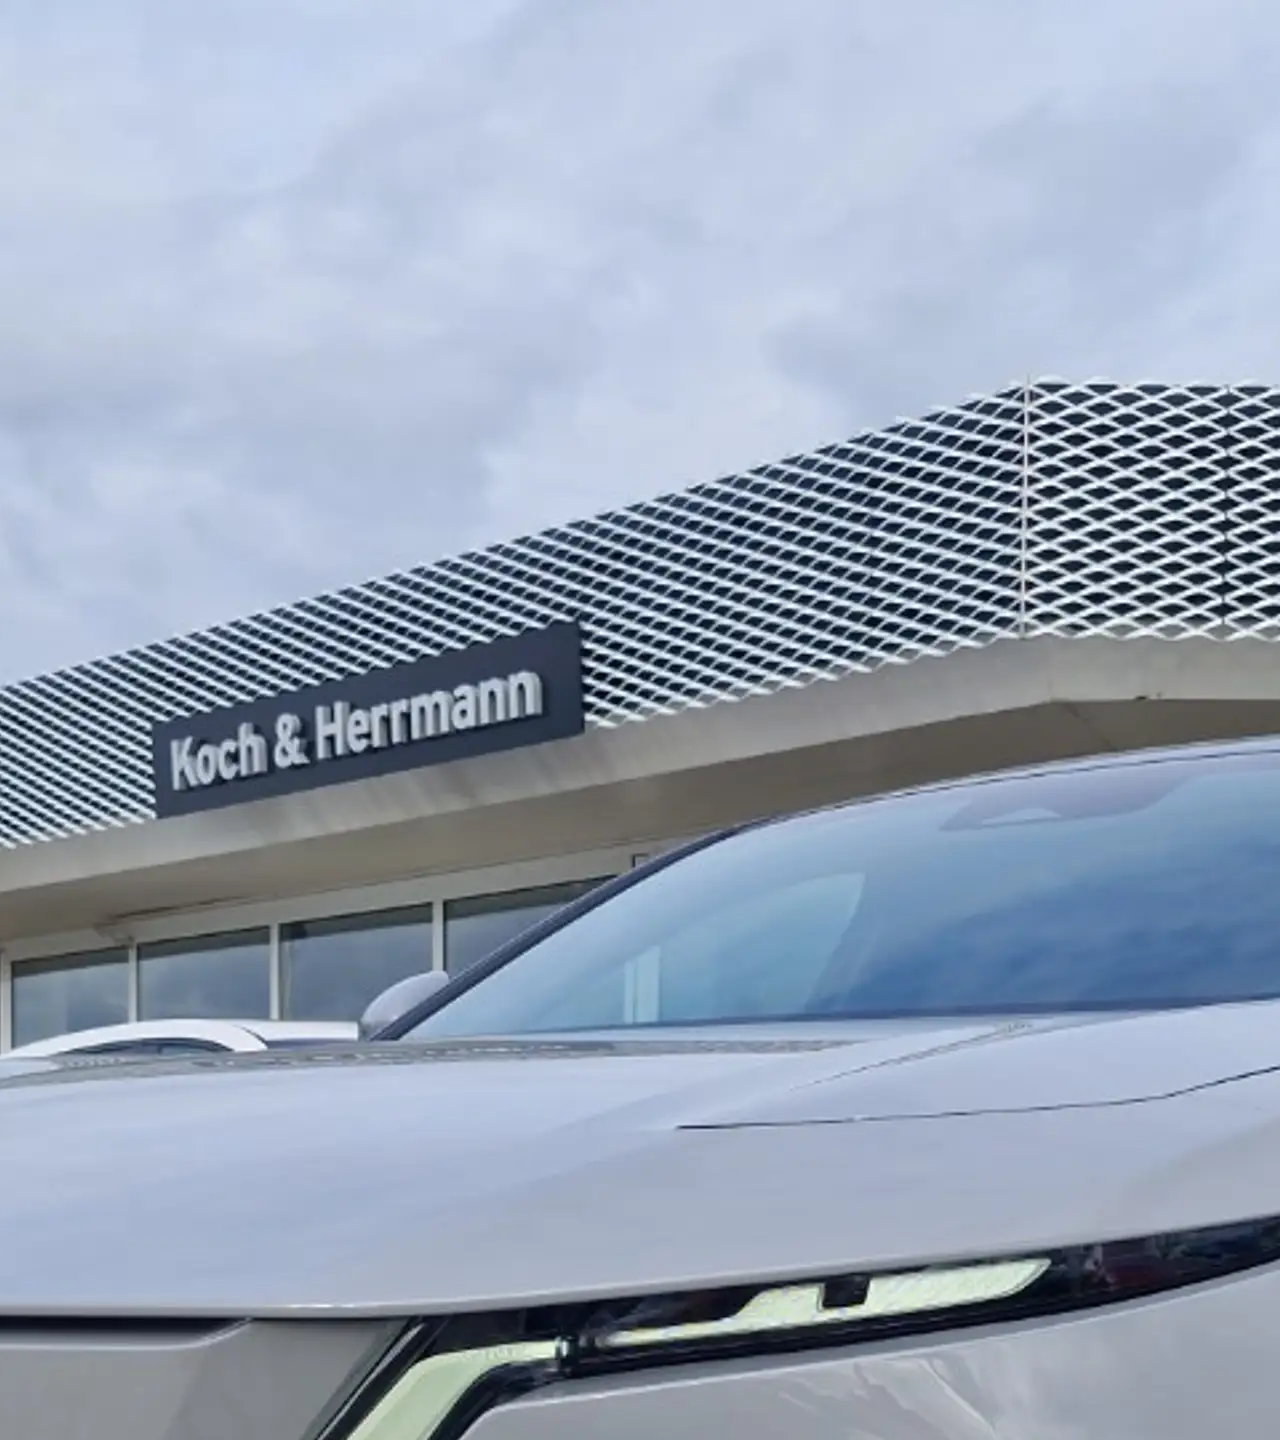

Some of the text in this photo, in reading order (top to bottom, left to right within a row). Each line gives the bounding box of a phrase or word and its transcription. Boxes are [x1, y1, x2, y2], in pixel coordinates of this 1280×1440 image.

[171, 669, 543, 791] Koch & Herrmann
